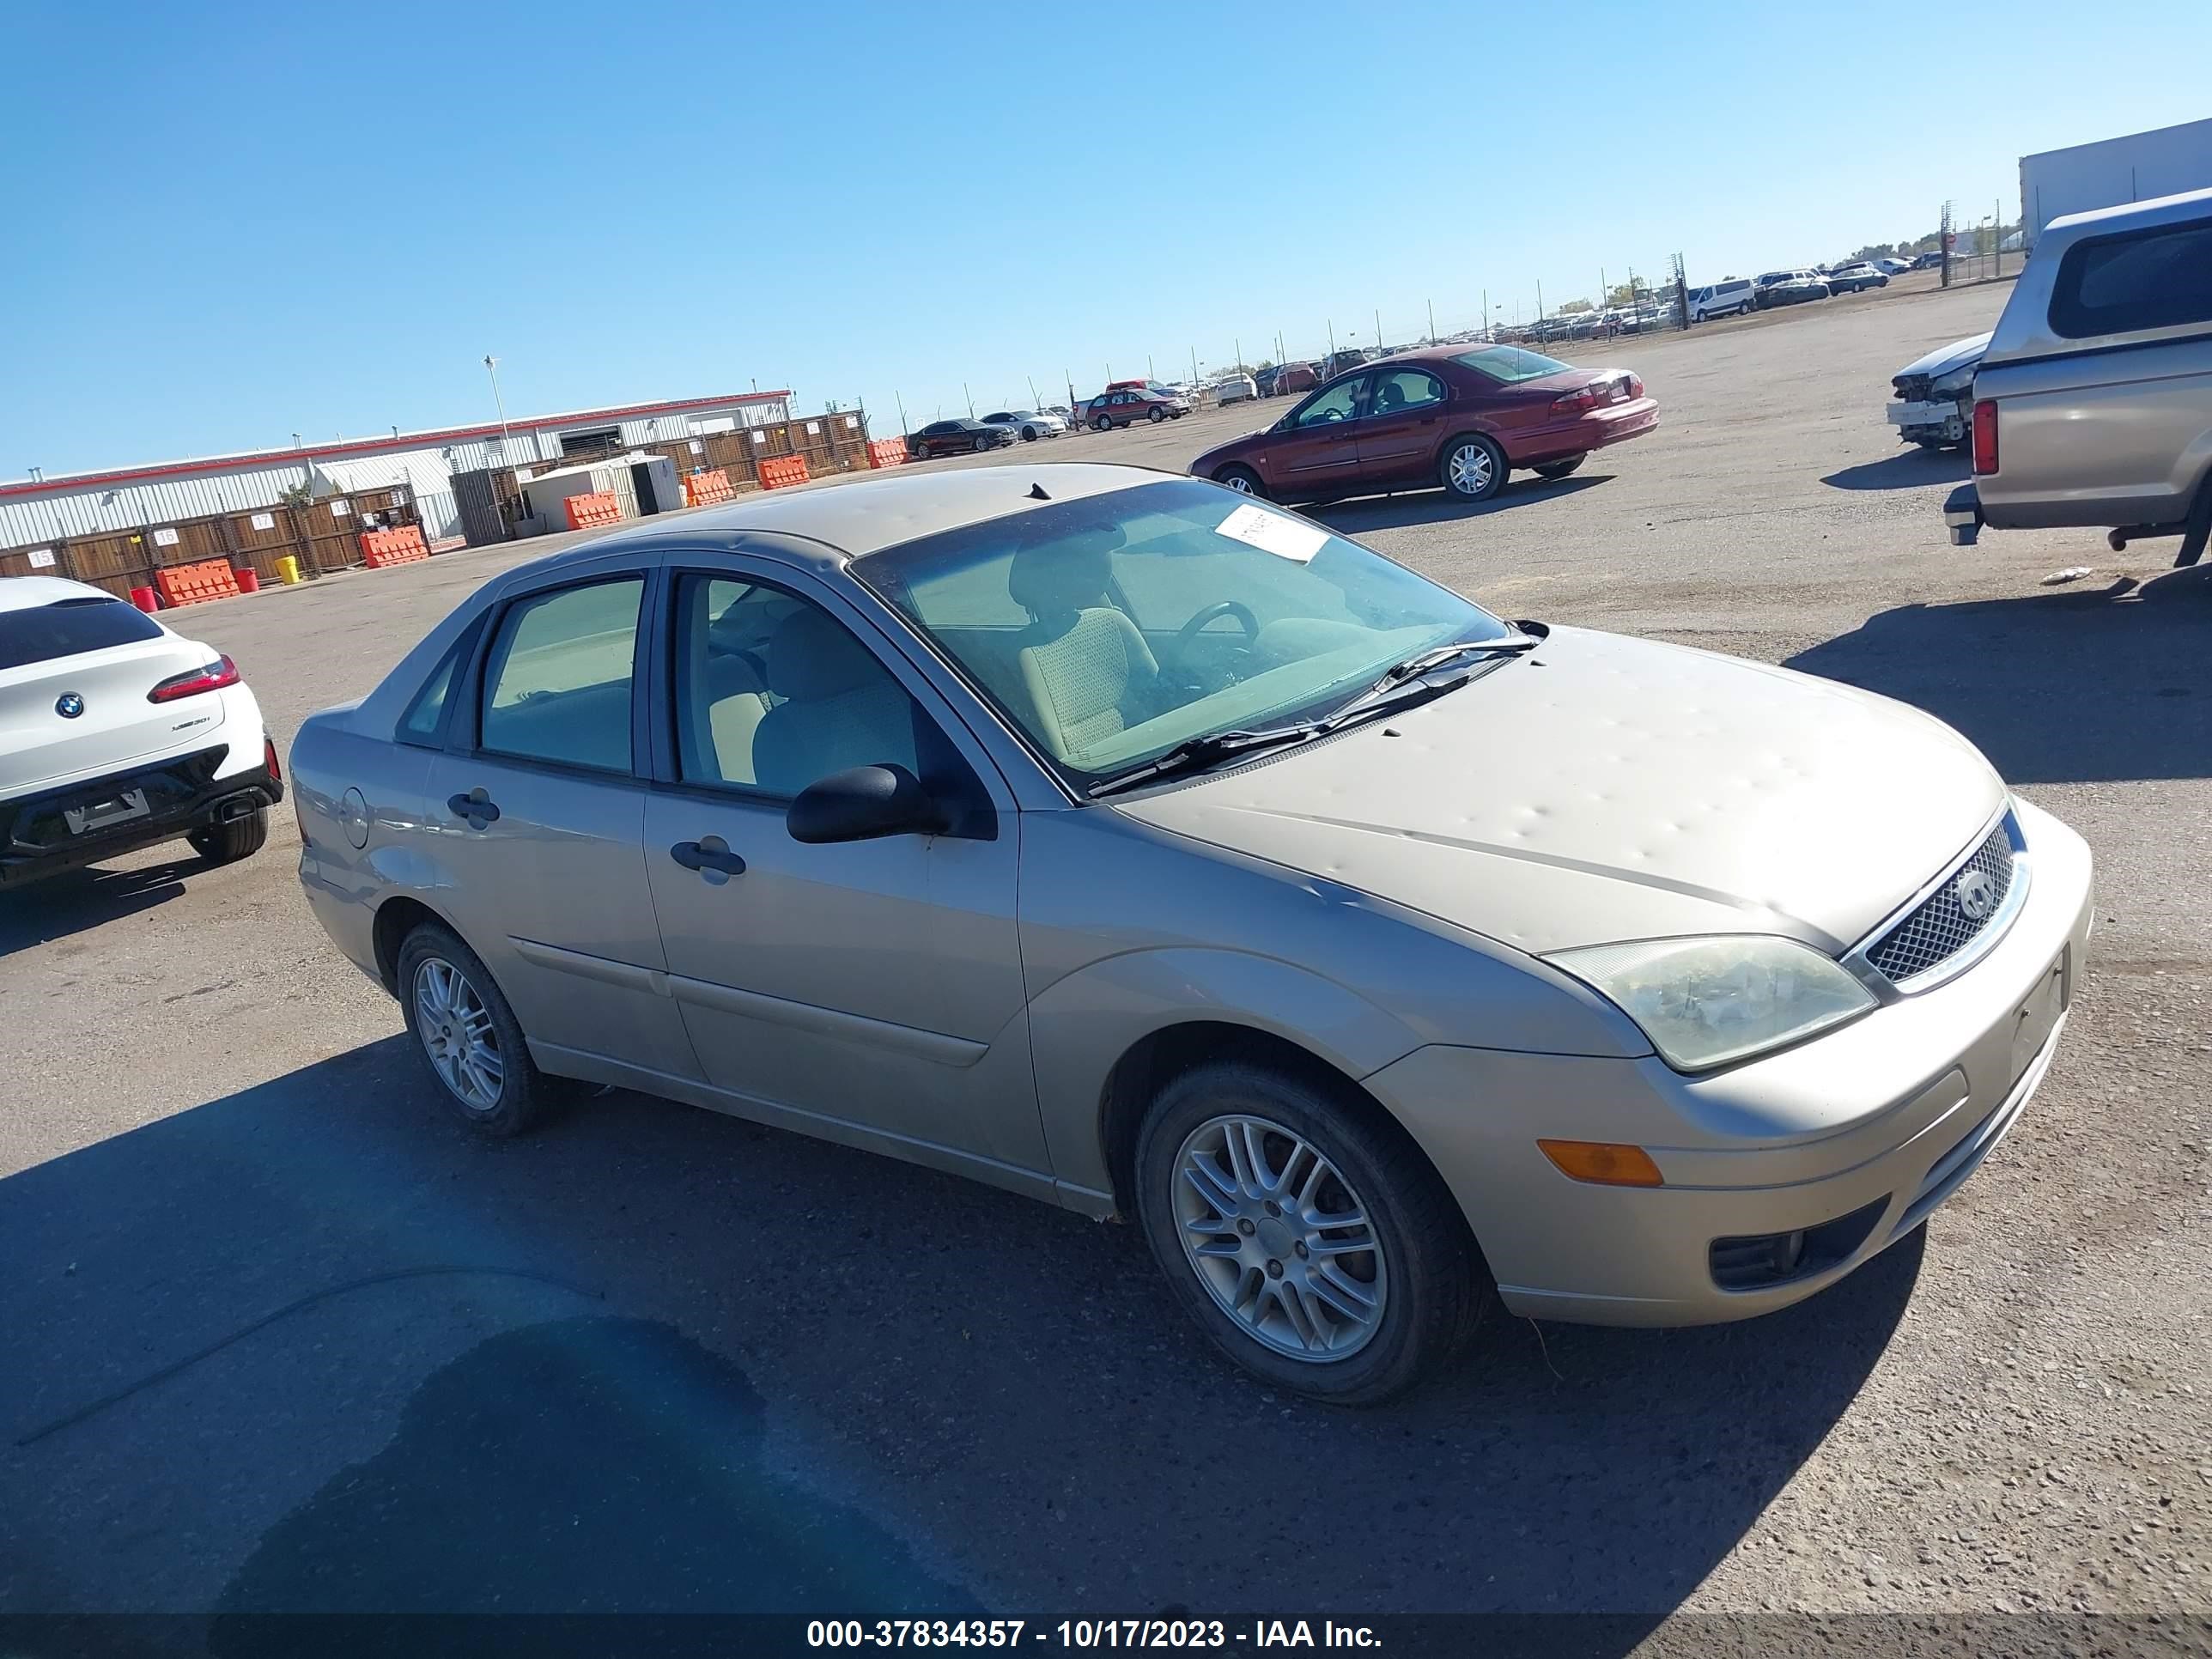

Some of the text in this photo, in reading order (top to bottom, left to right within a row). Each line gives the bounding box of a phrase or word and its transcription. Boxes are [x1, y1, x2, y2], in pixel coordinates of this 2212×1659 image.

[520, 471, 531, 482] 20
[253, 515, 268, 527] 17
[158, 531, 174, 543] 16
[34, 551, 50, 564] 15
